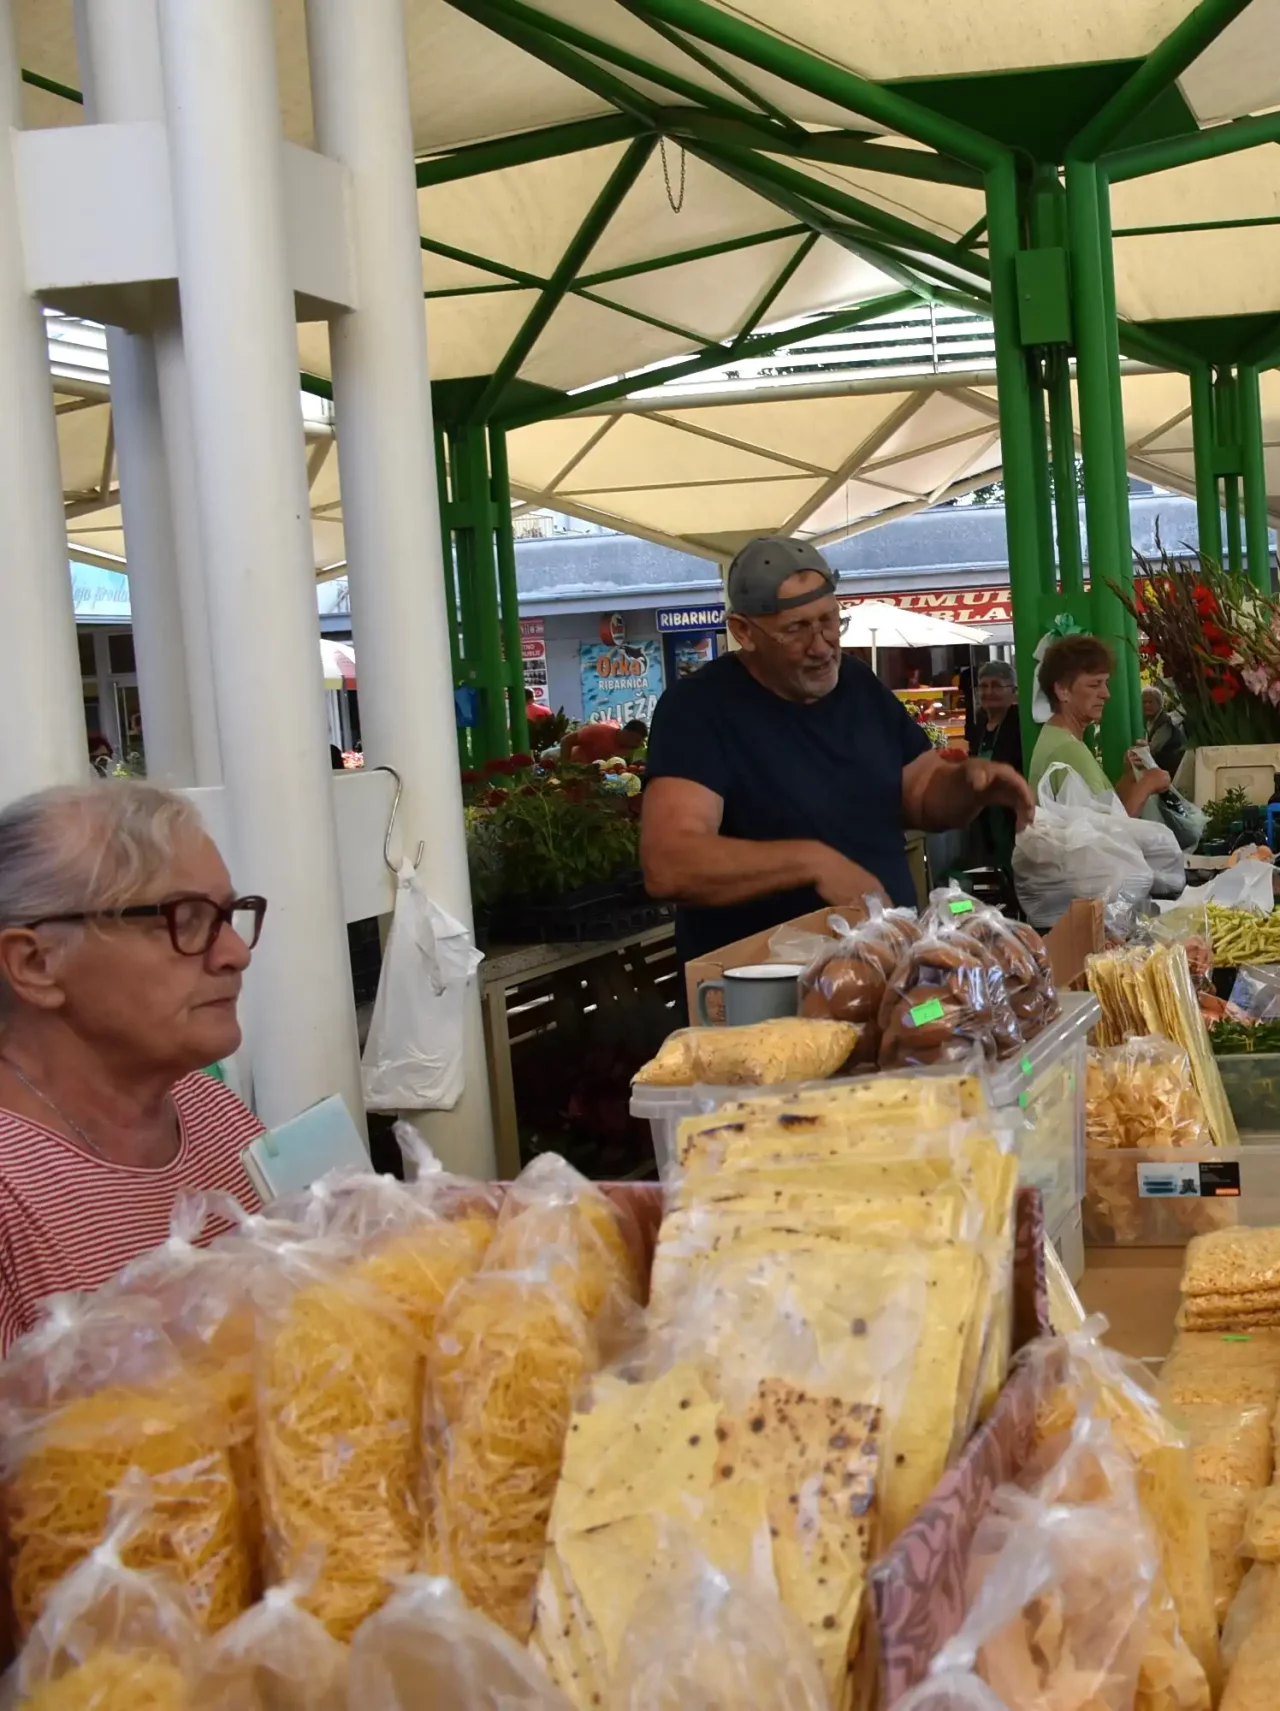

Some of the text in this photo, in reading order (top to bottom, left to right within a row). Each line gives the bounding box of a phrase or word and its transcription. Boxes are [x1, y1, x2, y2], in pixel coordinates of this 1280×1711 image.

[660, 610, 726, 627] RIBARNICA
[597, 655, 642, 678] Orka
[598, 679, 648, 690] RIBARNICA
